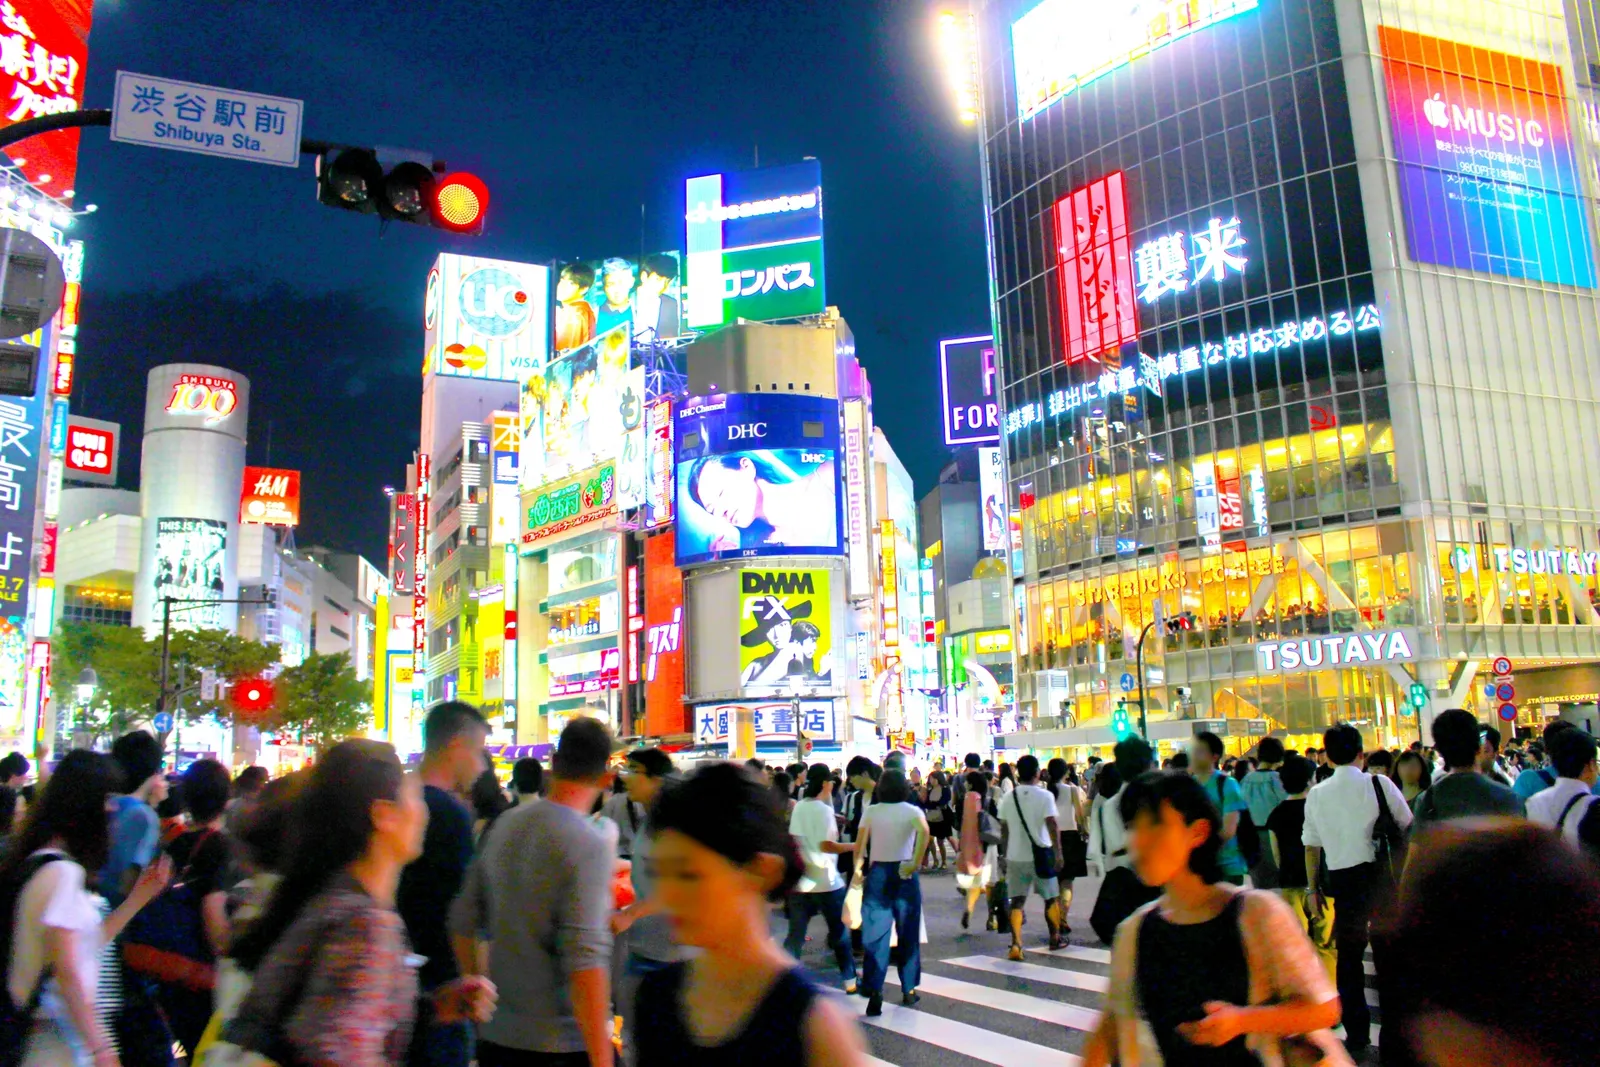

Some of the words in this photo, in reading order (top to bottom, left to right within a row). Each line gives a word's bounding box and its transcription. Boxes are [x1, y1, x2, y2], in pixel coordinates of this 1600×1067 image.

[131, 85, 287, 135] 渋谷駅前
[154, 122, 225, 147] Shibuya
[232, 133, 266, 152] Sta.
[1452, 104, 1545, 148] MUSIC
[1135, 217, 1250, 304] 襲来
[510, 357, 540, 368] VISA
[181, 375, 235, 390] SHIBUYA
[166, 384, 237, 426] 109
[72, 431, 107, 452] UNI
[728, 422, 768, 440] DHC
[71, 451, 108, 468] QLO
[801, 453, 825, 464] DHC
[254, 475, 289, 497] H&M
[850, 492, 862, 545] neon
[742, 572, 815, 595] DMM
[1075, 571, 1188, 606] STARBUCKS
[1199, 556, 1285, 585] COFFEE
[742, 596, 792, 620] FX
[1258, 631, 1413, 671] TSUTAYA
[1526, 695, 1569, 705] STARBUCKS
[1570, 693, 1600, 701] COFFEE
